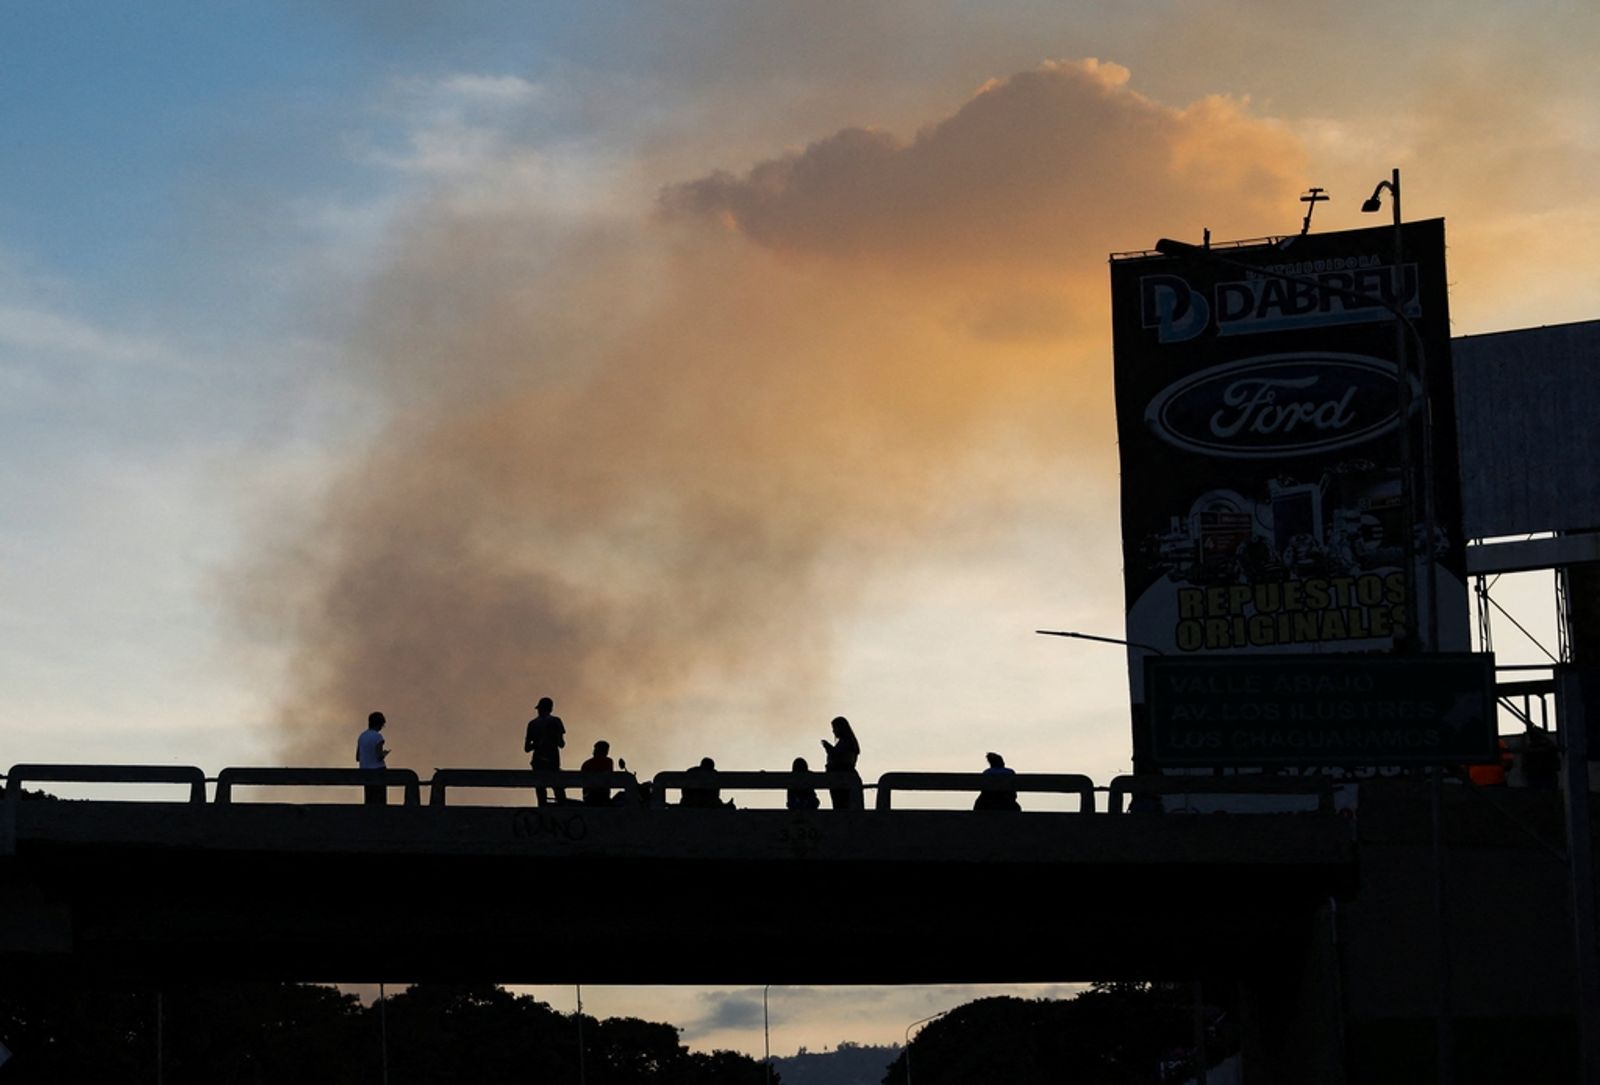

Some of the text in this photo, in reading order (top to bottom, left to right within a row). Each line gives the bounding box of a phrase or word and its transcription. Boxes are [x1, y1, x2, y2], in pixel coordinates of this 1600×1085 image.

[1209, 375, 1358, 438] Ford
[1177, 571, 1407, 620] REPUESTOS
[1169, 673, 1375, 693] VALLE ABAJO
[1222, 702, 1280, 720] LOS
[1290, 701, 1437, 720] ILUSTRES
[1168, 728, 1441, 749] LOS CHAGUARAMOS
